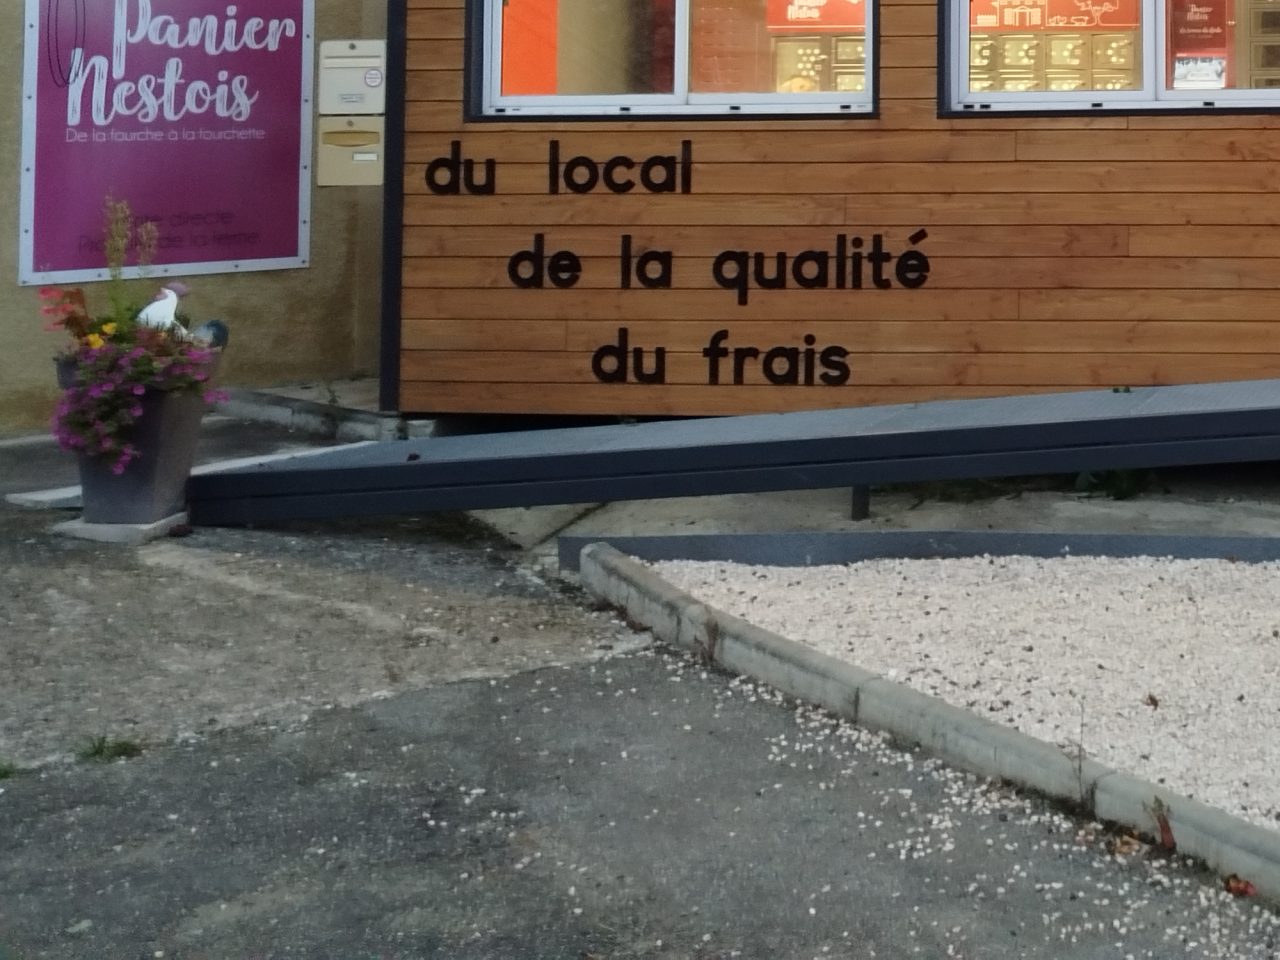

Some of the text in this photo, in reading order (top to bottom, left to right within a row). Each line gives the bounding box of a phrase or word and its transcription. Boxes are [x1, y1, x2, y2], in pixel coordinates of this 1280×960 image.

[67, 47, 259, 127] Nestois
[65, 128, 88, 143] De
[92, 128, 107, 142] la
[182, 127, 196, 141] la
[424, 140, 693, 195] du local
[507, 228, 930, 306] de la qualité
[592, 327, 851, 386] du frais
